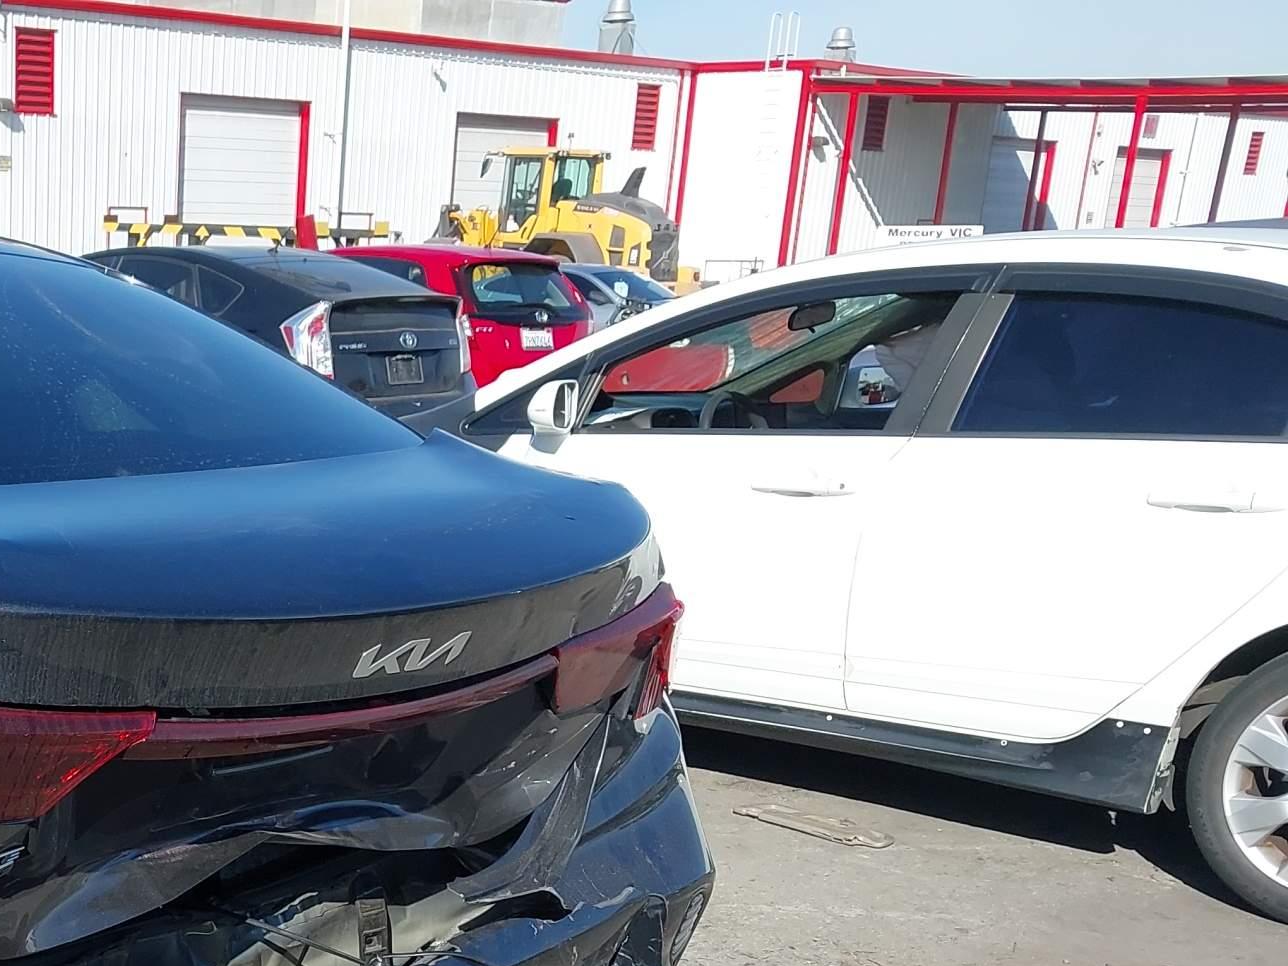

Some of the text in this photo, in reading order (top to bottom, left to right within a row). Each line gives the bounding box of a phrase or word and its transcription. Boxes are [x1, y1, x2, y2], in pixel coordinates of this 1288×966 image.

[888, 228, 972, 238] Mercury VIC
[352, 630, 473, 679] KIA
